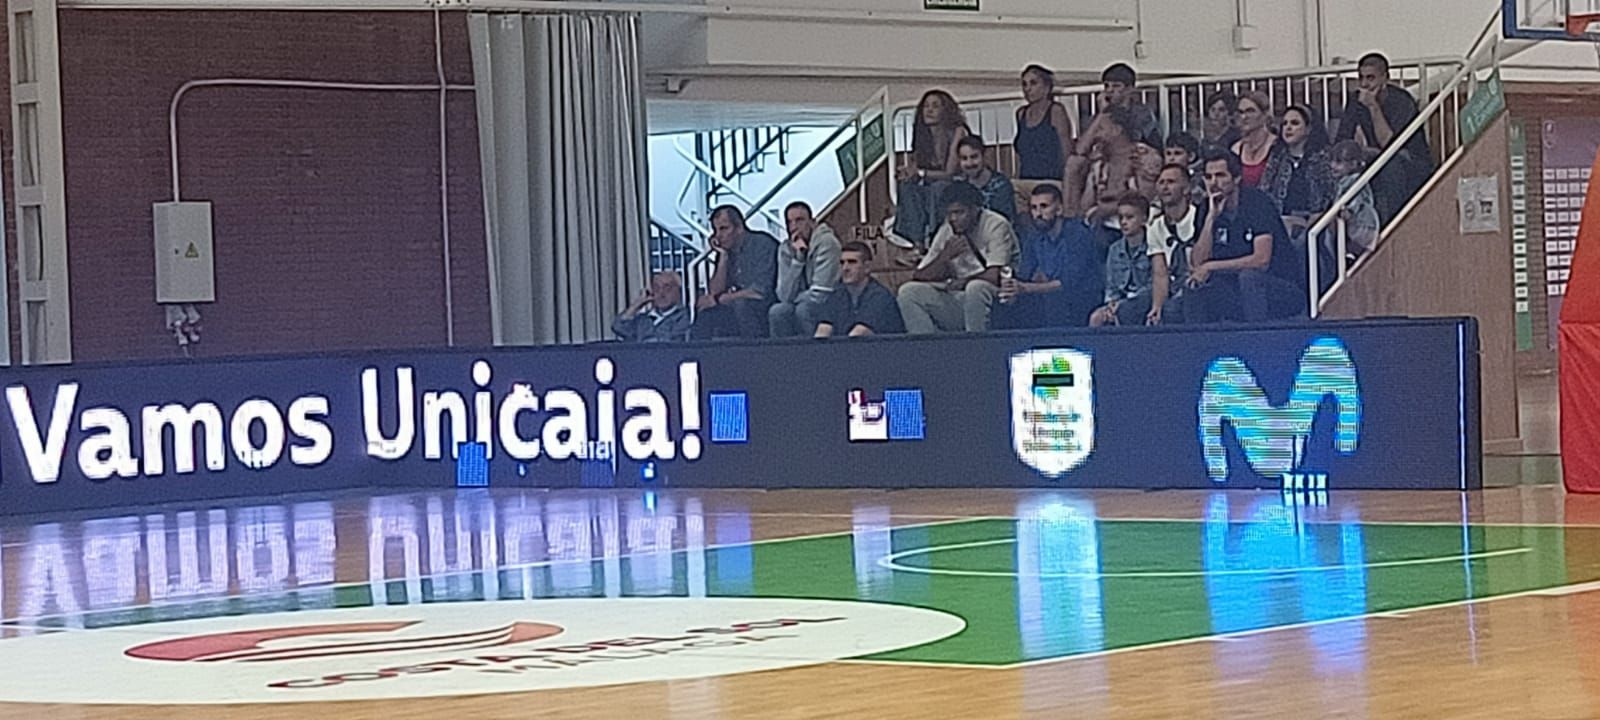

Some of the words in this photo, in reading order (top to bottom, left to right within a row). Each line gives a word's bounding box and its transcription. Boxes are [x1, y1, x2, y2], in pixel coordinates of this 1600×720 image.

[854, 226, 885, 240] FILA
[5, 382, 334, 483] Vamos
[361, 358, 701, 470] Unicaja!
[267, 653, 546, 689] COSTA
[534, 635, 701, 653] DEL
[686, 616, 847, 635] SOL
